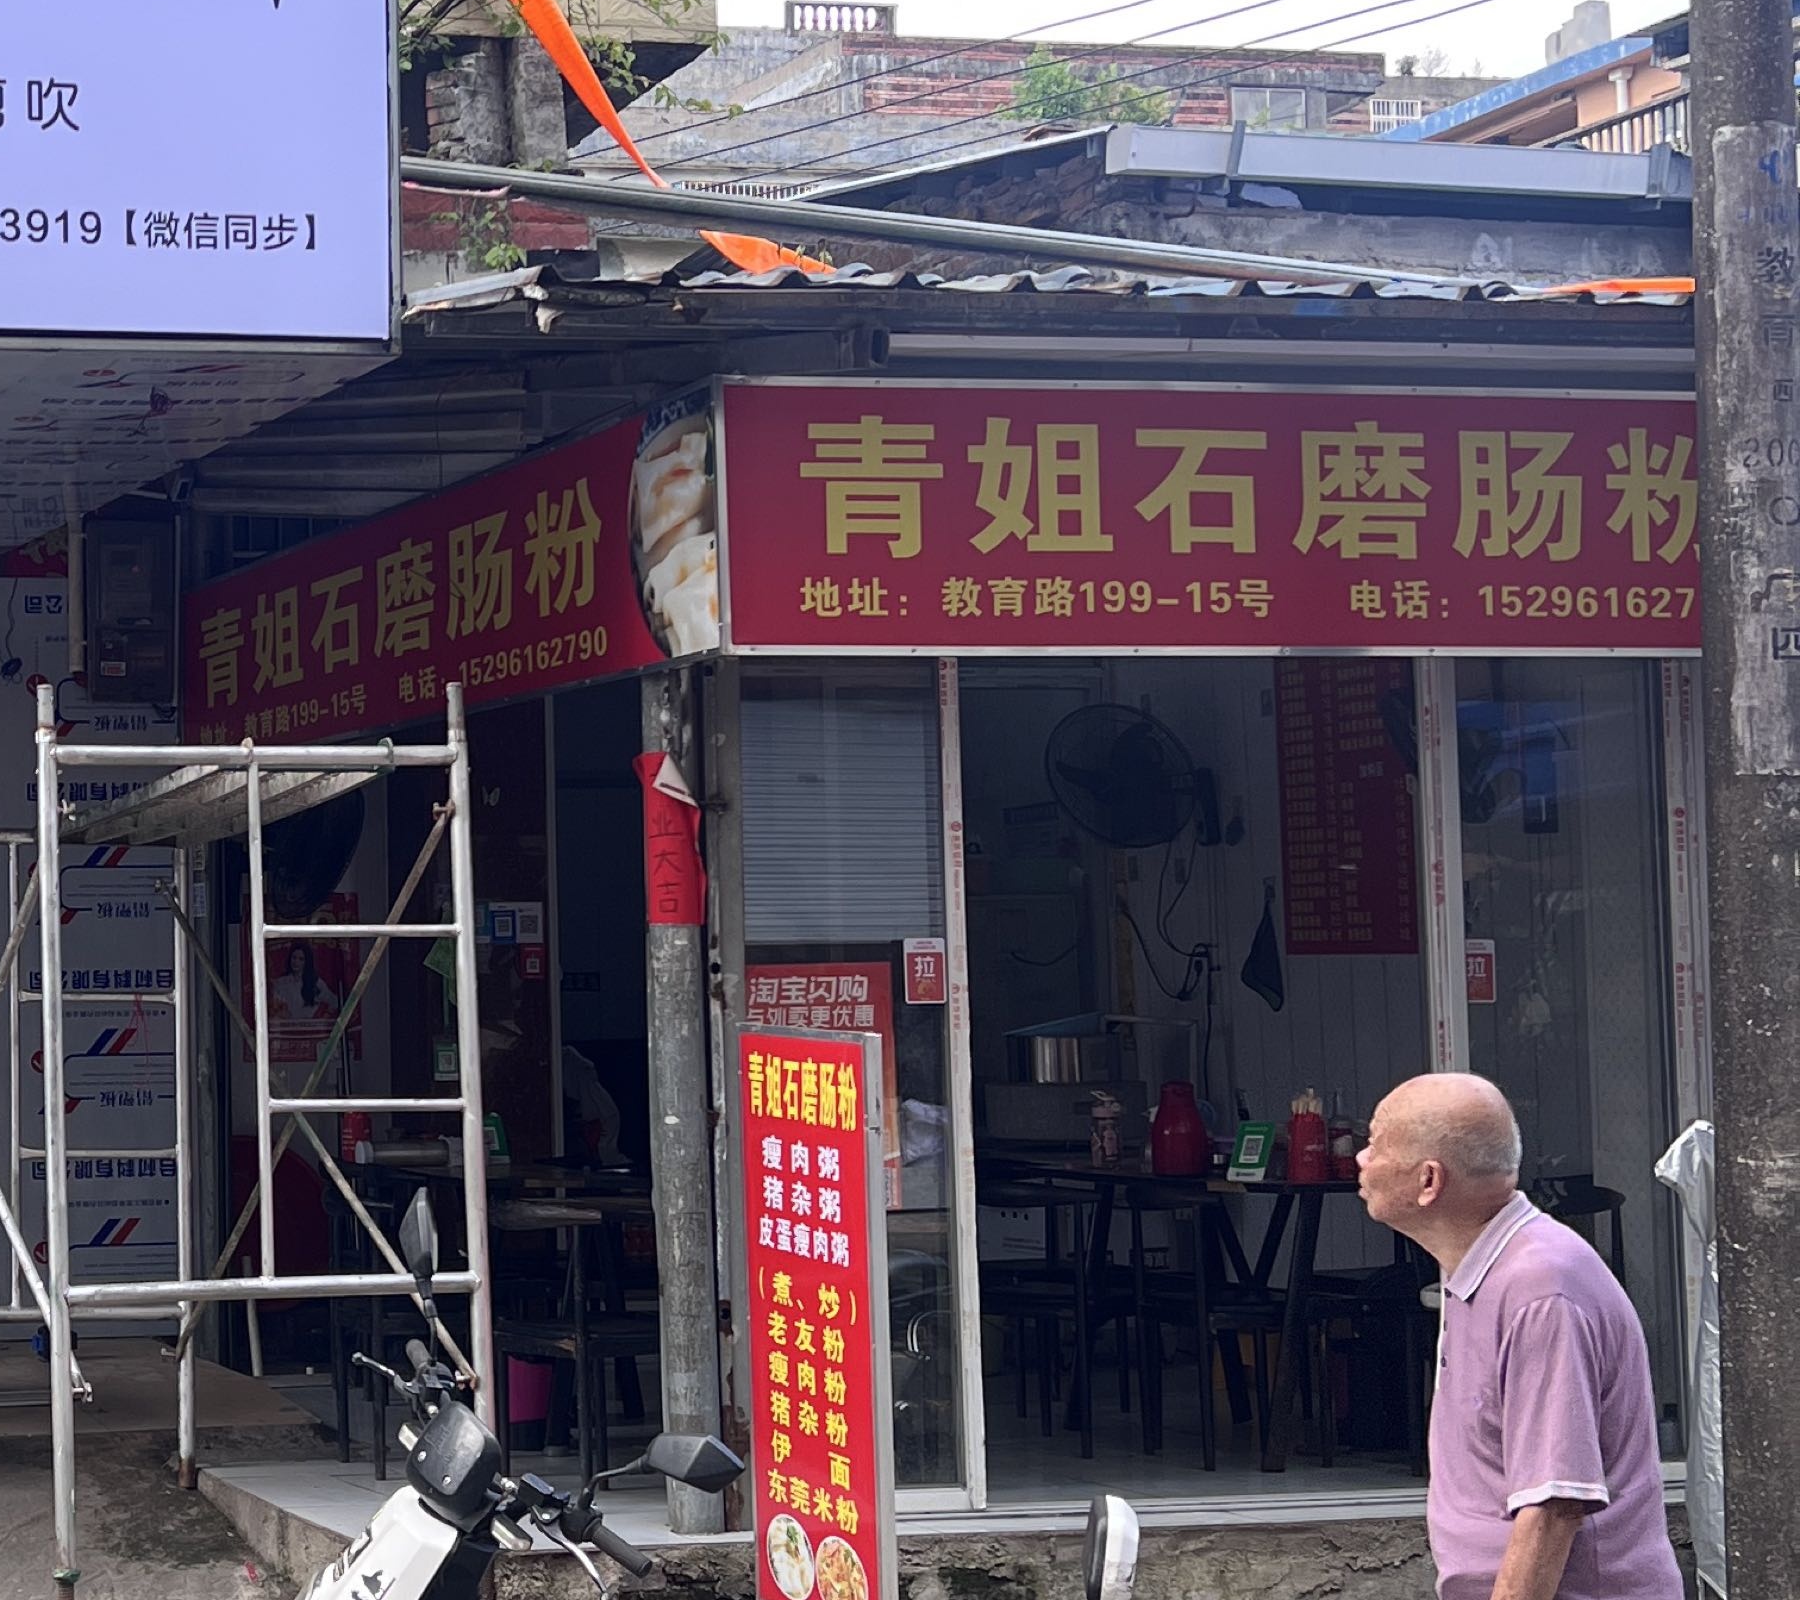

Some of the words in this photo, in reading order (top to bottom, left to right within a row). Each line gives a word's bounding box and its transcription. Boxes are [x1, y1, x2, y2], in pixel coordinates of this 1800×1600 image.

[798, 415, 1699, 563] 青姐石磨肠粉
[199, 477, 602, 709] 青姐石磨肠粉
[647, 772, 685, 914] 业大吉
[749, 974, 869, 1006] 淘宝闪购
[914, 956, 936, 978] 拉
[747, 1050, 858, 1132] 青姐石磨肠粉
[761, 1135, 841, 1182] 瘦肉粥
[762, 1175, 842, 1224] 猪杂粥
[758, 1213, 850, 1268] 皮蛋瘦肉粥
[767, 1309, 846, 1364] 老友粉
[768, 1350, 847, 1406] 瘦肉粉
[769, 1389, 849, 1448] 猪杂粉
[767, 1467, 859, 1535] 东莞米粉
